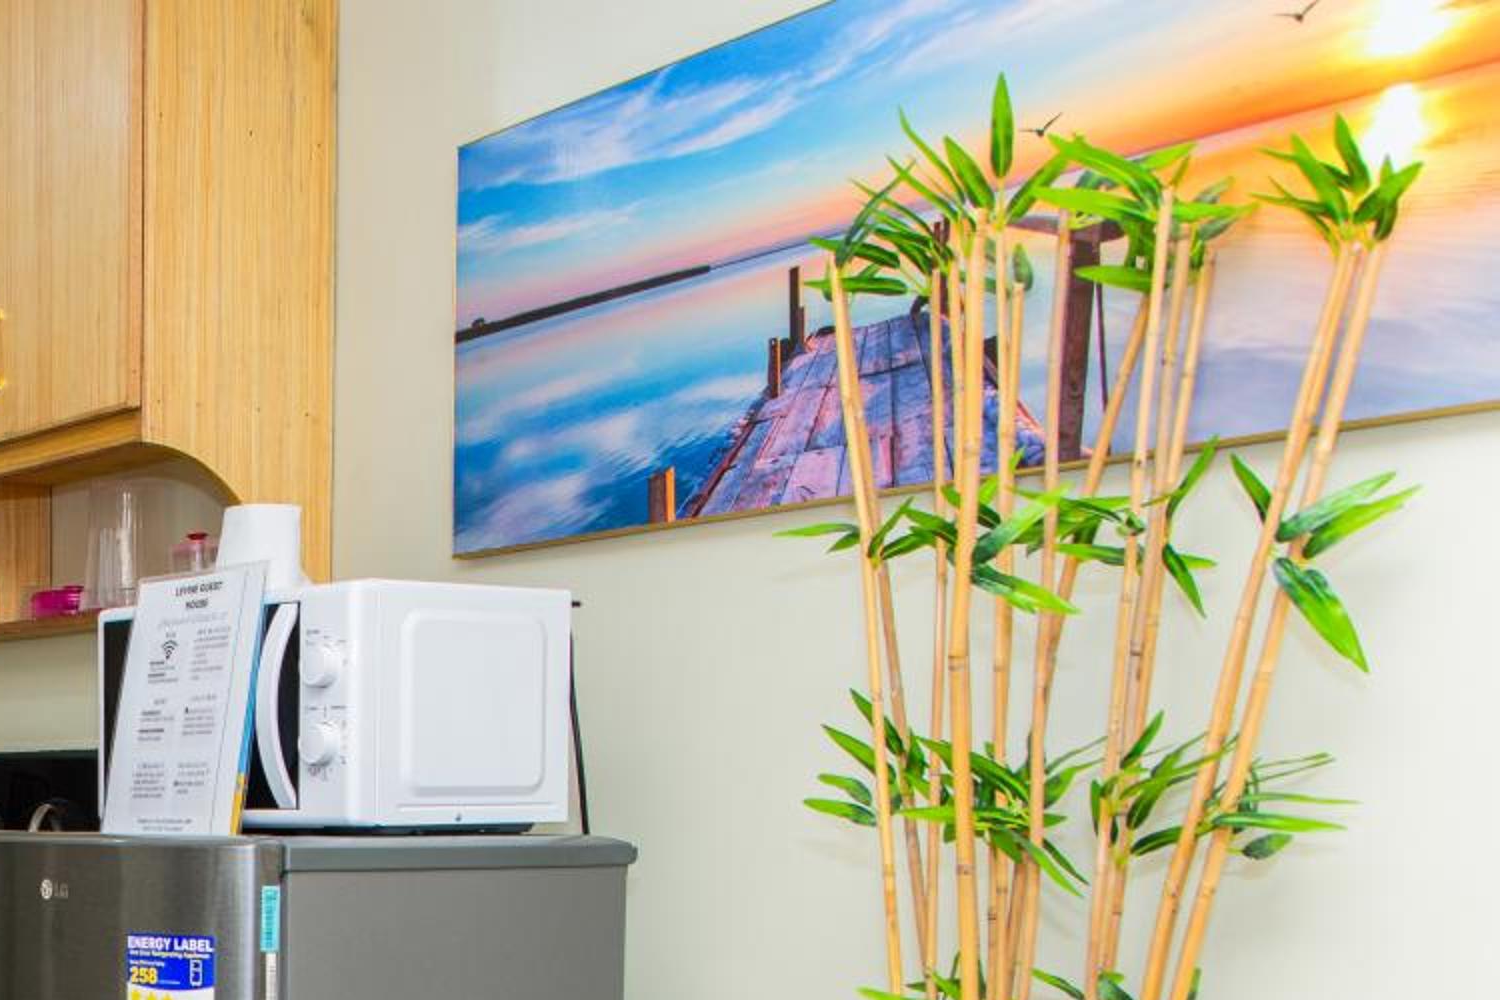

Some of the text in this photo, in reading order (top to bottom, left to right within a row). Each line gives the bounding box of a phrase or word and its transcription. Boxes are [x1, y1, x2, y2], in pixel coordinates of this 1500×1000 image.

[128, 935, 214, 952] ENERGY LABEL
[130, 967, 158, 985] 258
